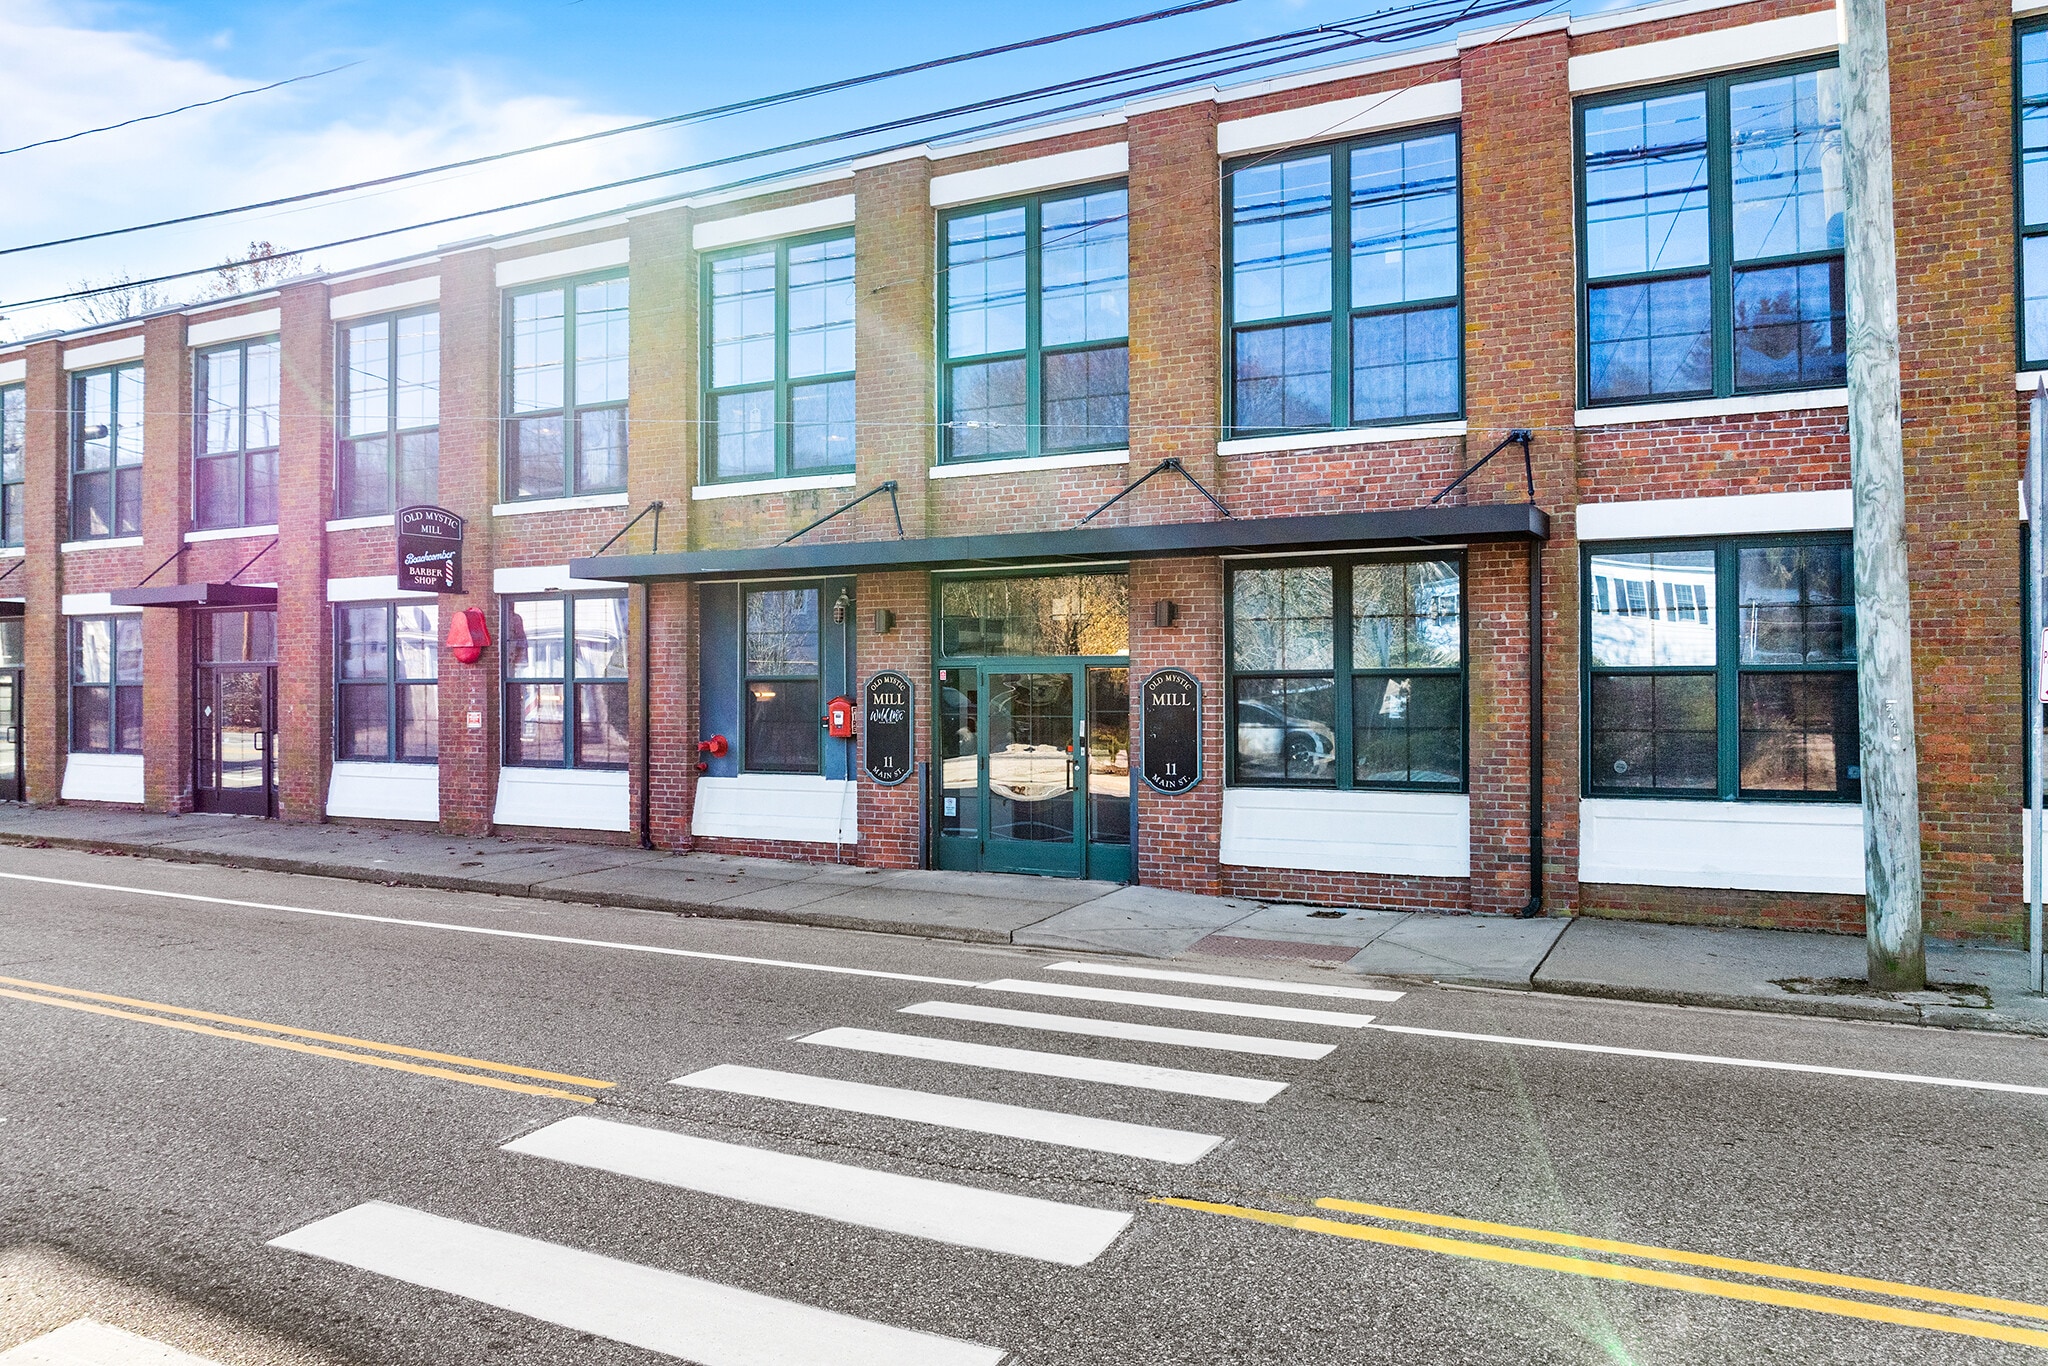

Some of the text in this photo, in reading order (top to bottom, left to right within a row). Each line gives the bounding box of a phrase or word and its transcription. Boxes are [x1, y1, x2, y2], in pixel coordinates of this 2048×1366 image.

[404, 512, 458, 529] OLD MYSTIC
[421, 525, 442, 535] MILL
[405, 550, 456, 565] Beachcomber
[409, 567, 443, 577] BARBER
[414, 576, 437, 585] SHOP
[870, 677, 905, 691] OLD MYSTIC
[1149, 675, 1192, 691] OLD MYSTIC
[873, 693, 905, 705] MILL
[1152, 693, 1191, 706] MILL
[883, 756, 893, 768] 11
[872, 766, 905, 779] MAIN ST.
[1165, 763, 1177, 776] 11
[1152, 773, 1191, 788] MAIN ST.
